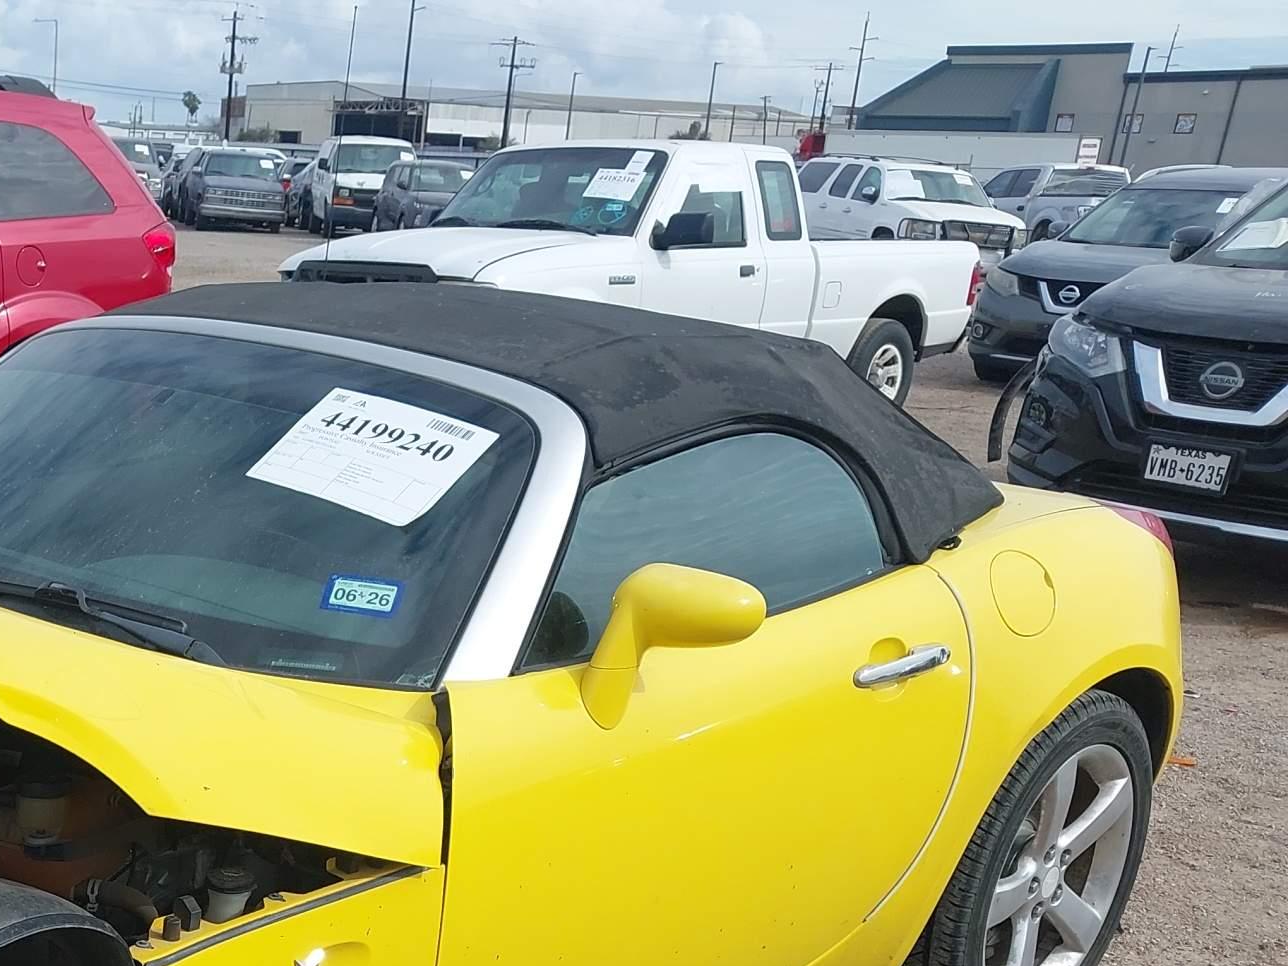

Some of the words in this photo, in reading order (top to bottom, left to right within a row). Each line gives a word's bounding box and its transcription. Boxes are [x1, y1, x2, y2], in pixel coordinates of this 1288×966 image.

[1203, 374, 1240, 386] NISSAN
[320, 411, 454, 462] 44199240
[1175, 447, 1207, 459] TEXAS
